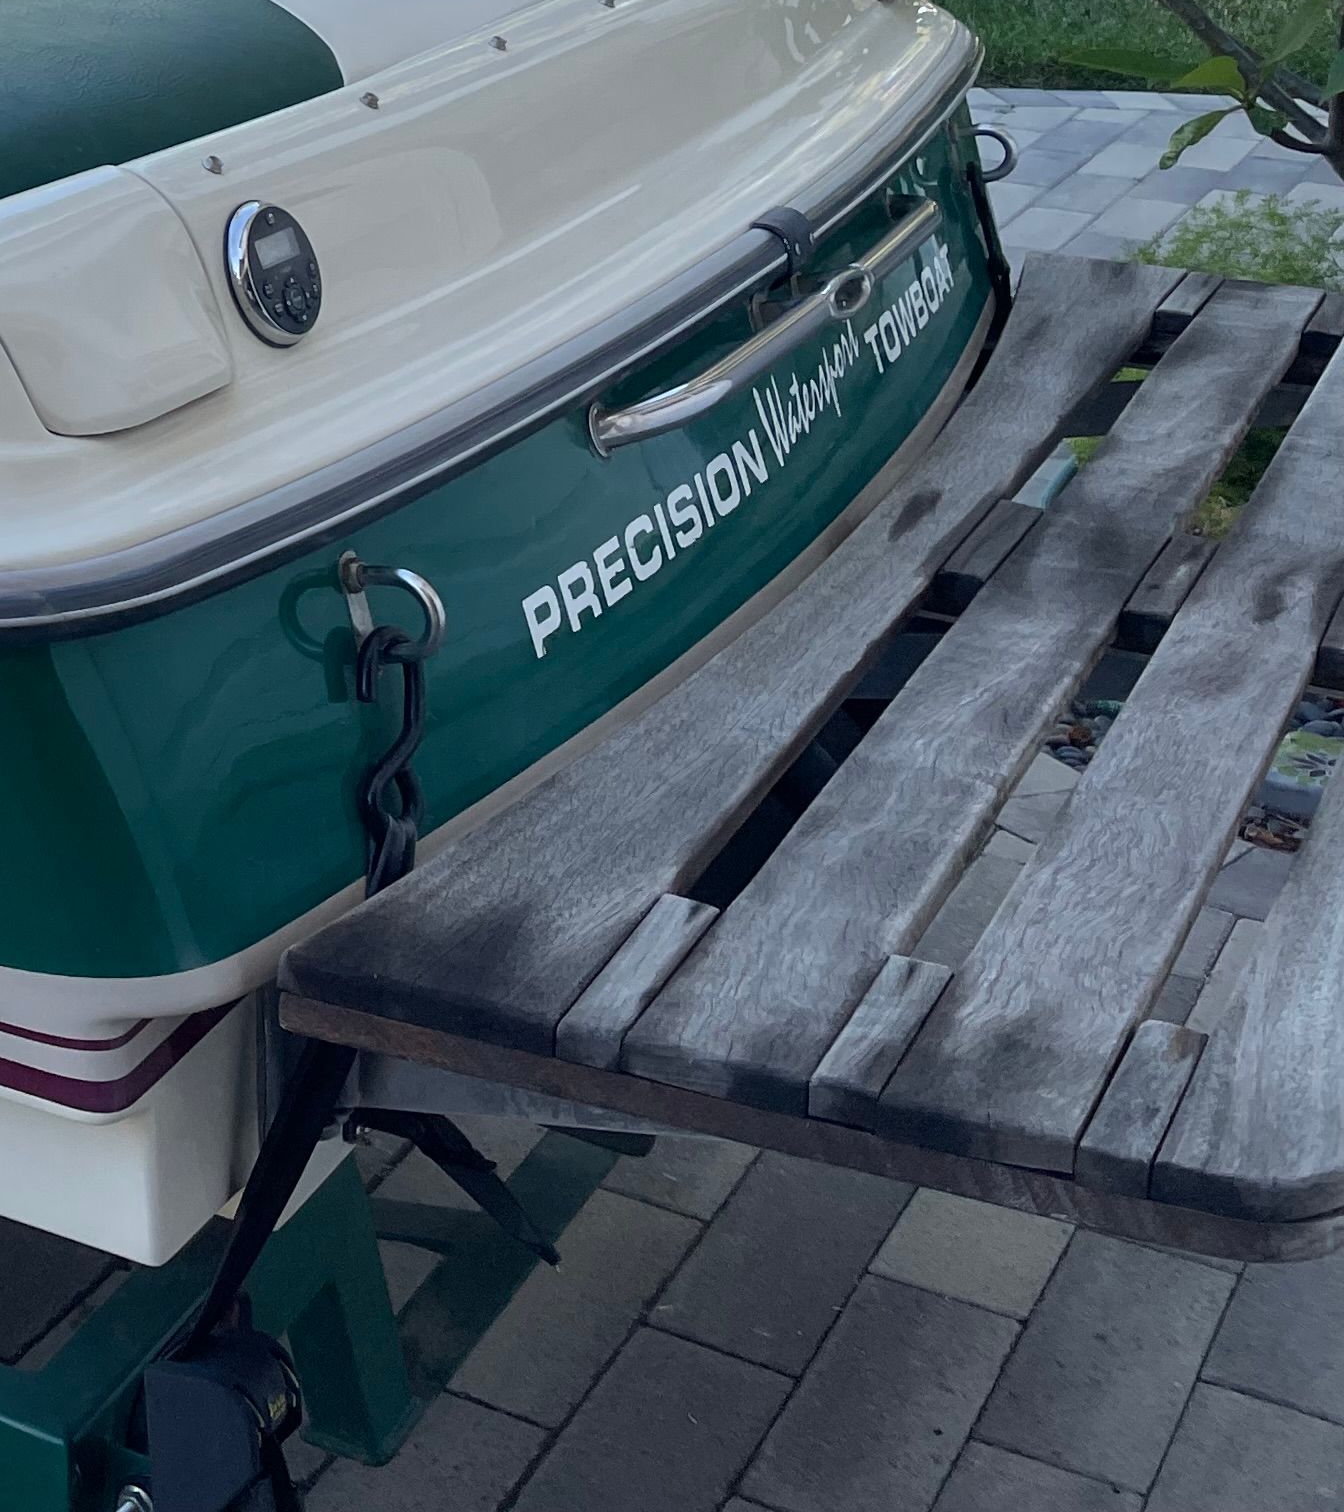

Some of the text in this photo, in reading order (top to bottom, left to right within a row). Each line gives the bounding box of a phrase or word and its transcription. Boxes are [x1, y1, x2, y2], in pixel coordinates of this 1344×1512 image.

[522, 242, 956, 659] PRECISION Watersport TOWBOAT
